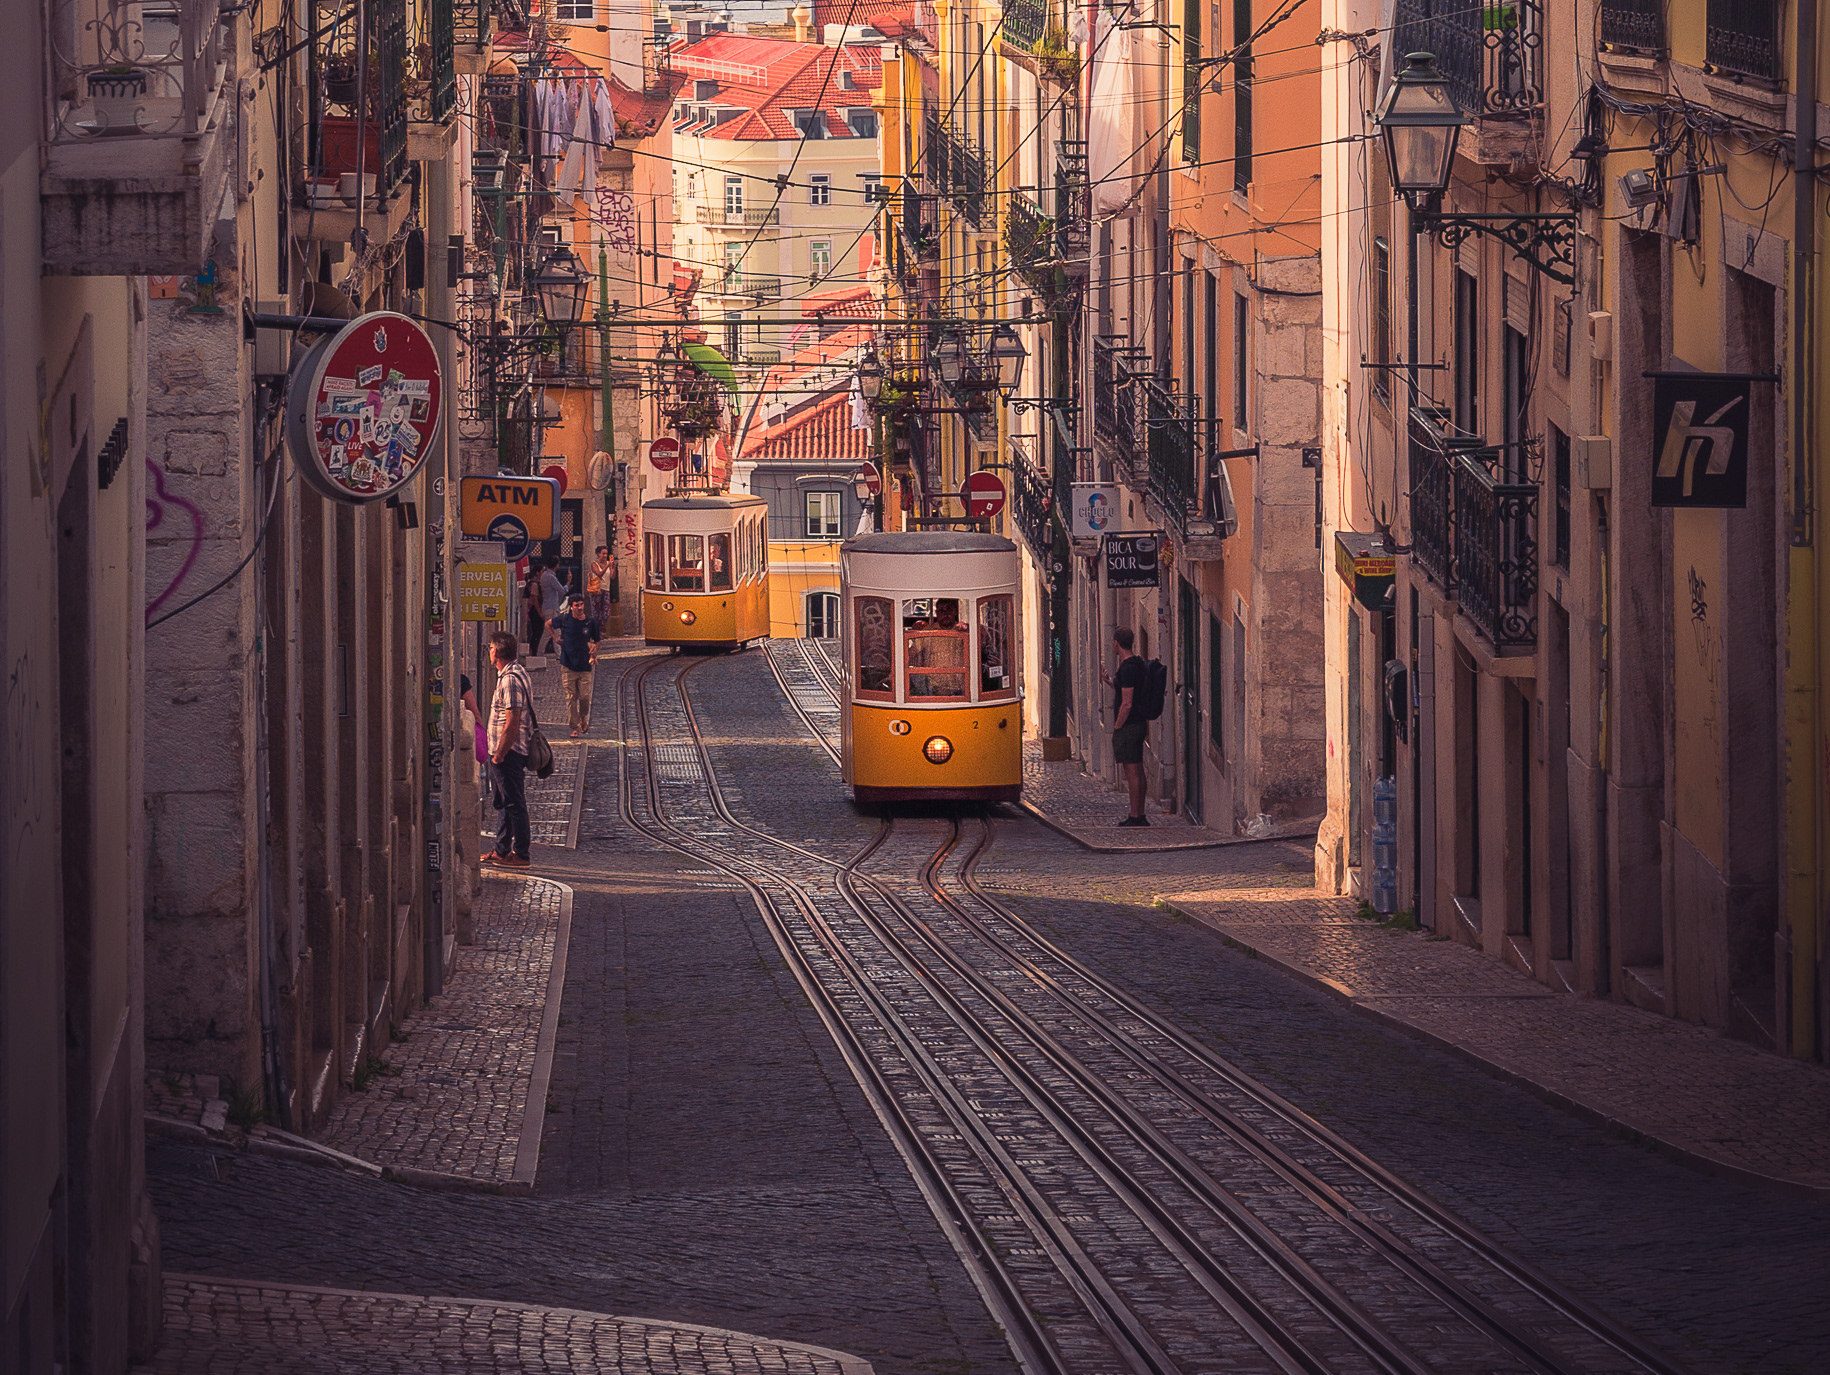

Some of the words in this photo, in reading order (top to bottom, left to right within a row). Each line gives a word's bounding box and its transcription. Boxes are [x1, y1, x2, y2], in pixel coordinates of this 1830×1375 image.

[347, 442, 362, 450] LIVE
[476, 484, 539, 506] ATM
[1108, 541, 1132, 554] BICA
[1108, 556, 1136, 570] SOUR
[461, 571, 503, 582] ERVEJA
[461, 587, 504, 597] ERVEZA
[460, 602, 500, 613] IÈRE
[972, 721, 979, 729] 2
